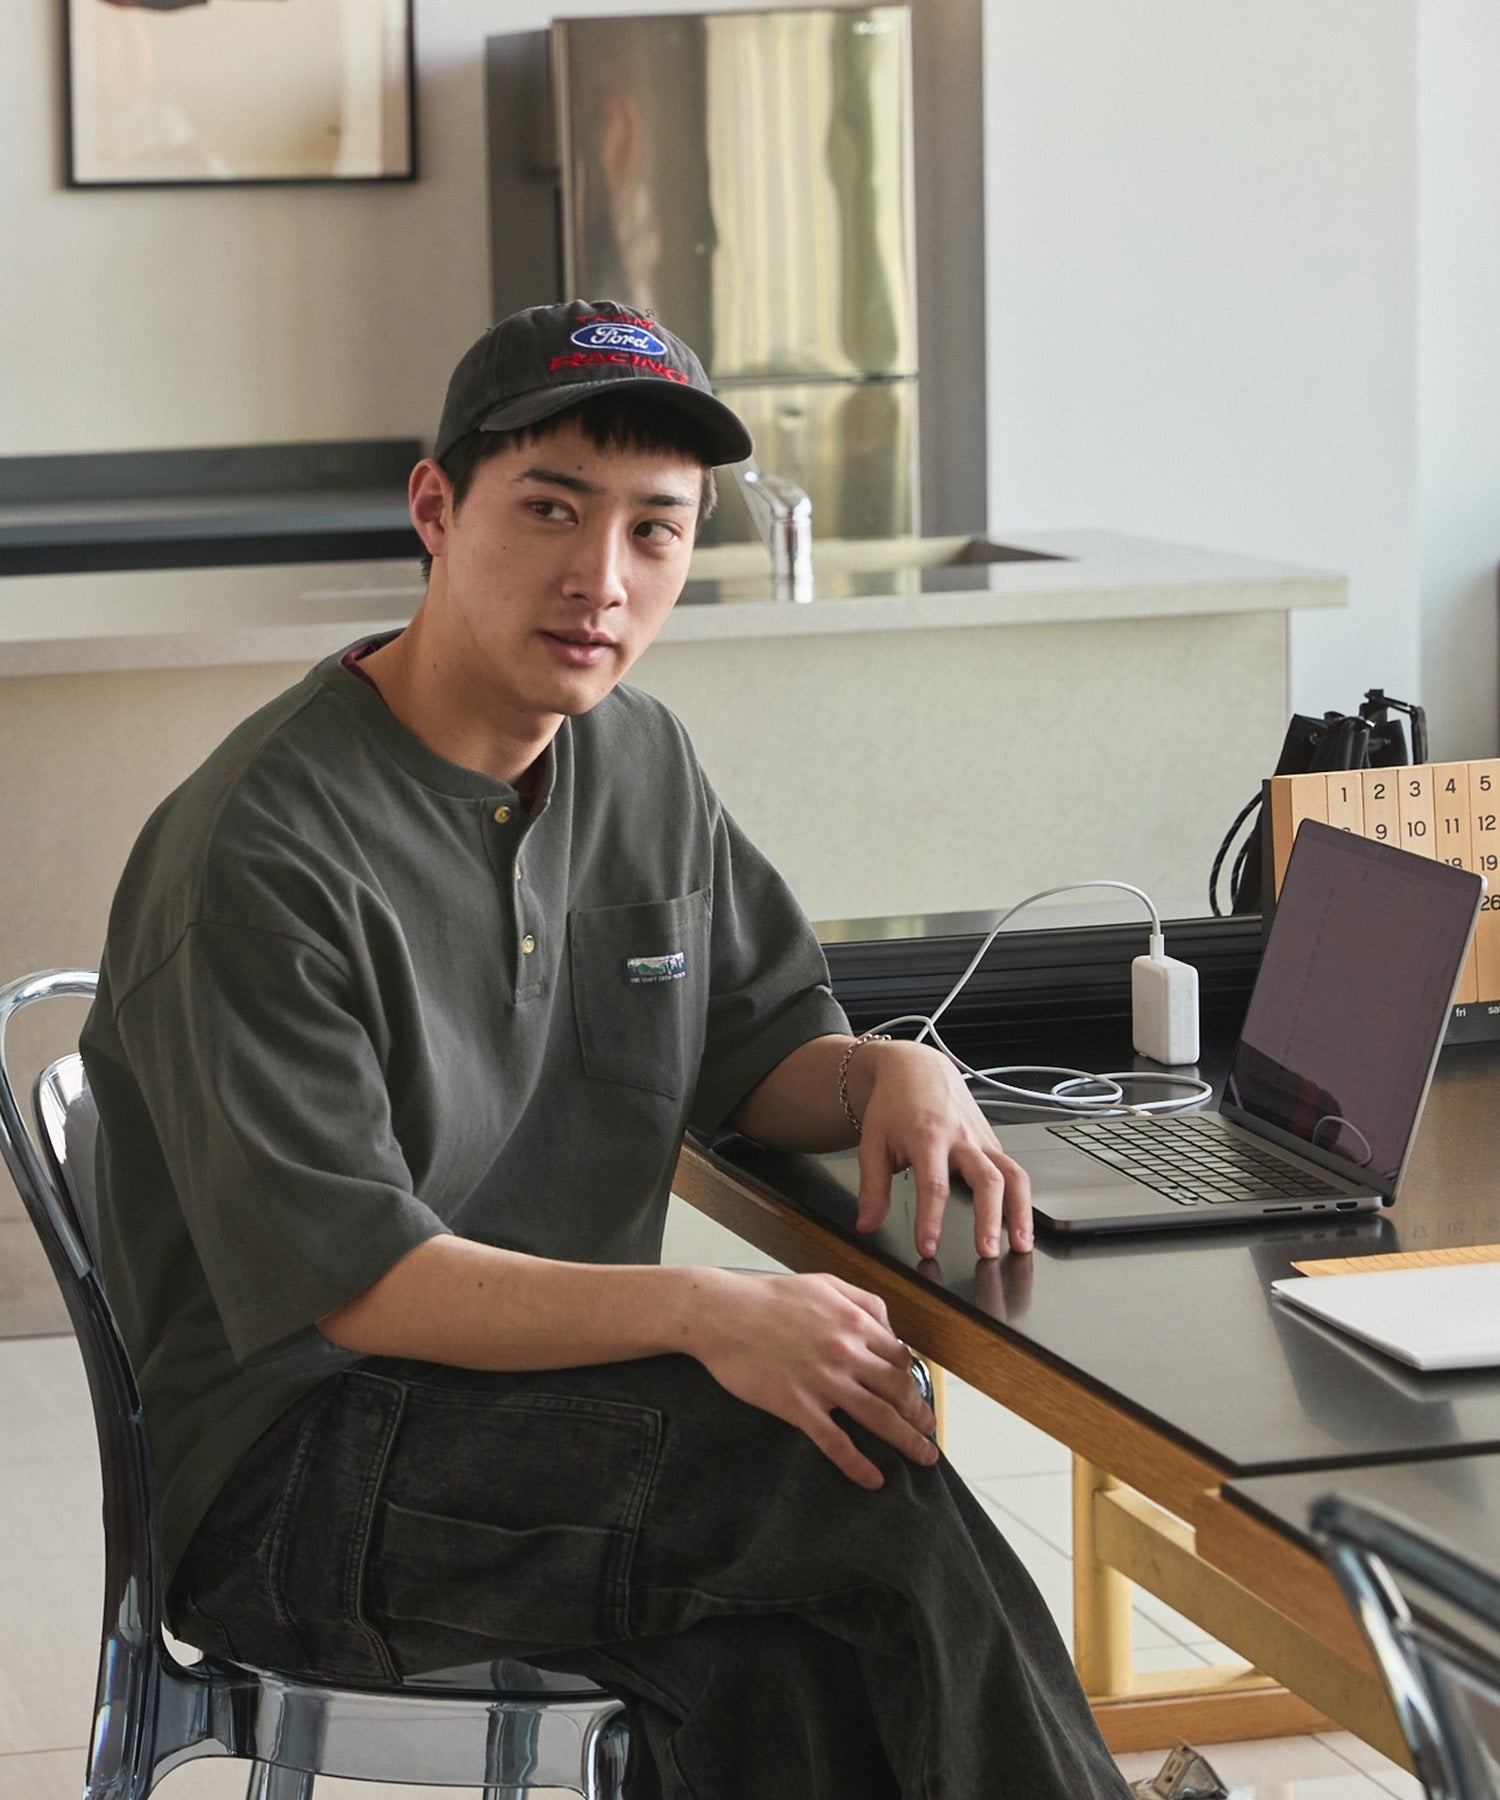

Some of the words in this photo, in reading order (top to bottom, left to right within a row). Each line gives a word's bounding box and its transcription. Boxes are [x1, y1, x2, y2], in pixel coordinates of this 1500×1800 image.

[576, 314, 654, 330] TEAM
[590, 326, 650, 349] Ford
[549, 352, 689, 385] RACING
[1341, 787, 1347, 803] 1
[1373, 783, 1386, 800] 2
[1409, 780, 1421, 797] 3
[1445, 778, 1456, 794] 4
[1479, 775, 1492, 791] 5
[1375, 823, 1388, 840] 9
[1407, 820, 1427, 837] 10
[1444, 818, 1460, 834] 11
[1477, 814, 1497, 831] 12
[1479, 854, 1498, 872] 19
[1480, 893, 1500, 912] 26
[1455, 1007, 1467, 1018] fri
[1487, 1005, 1500, 1015] sa
